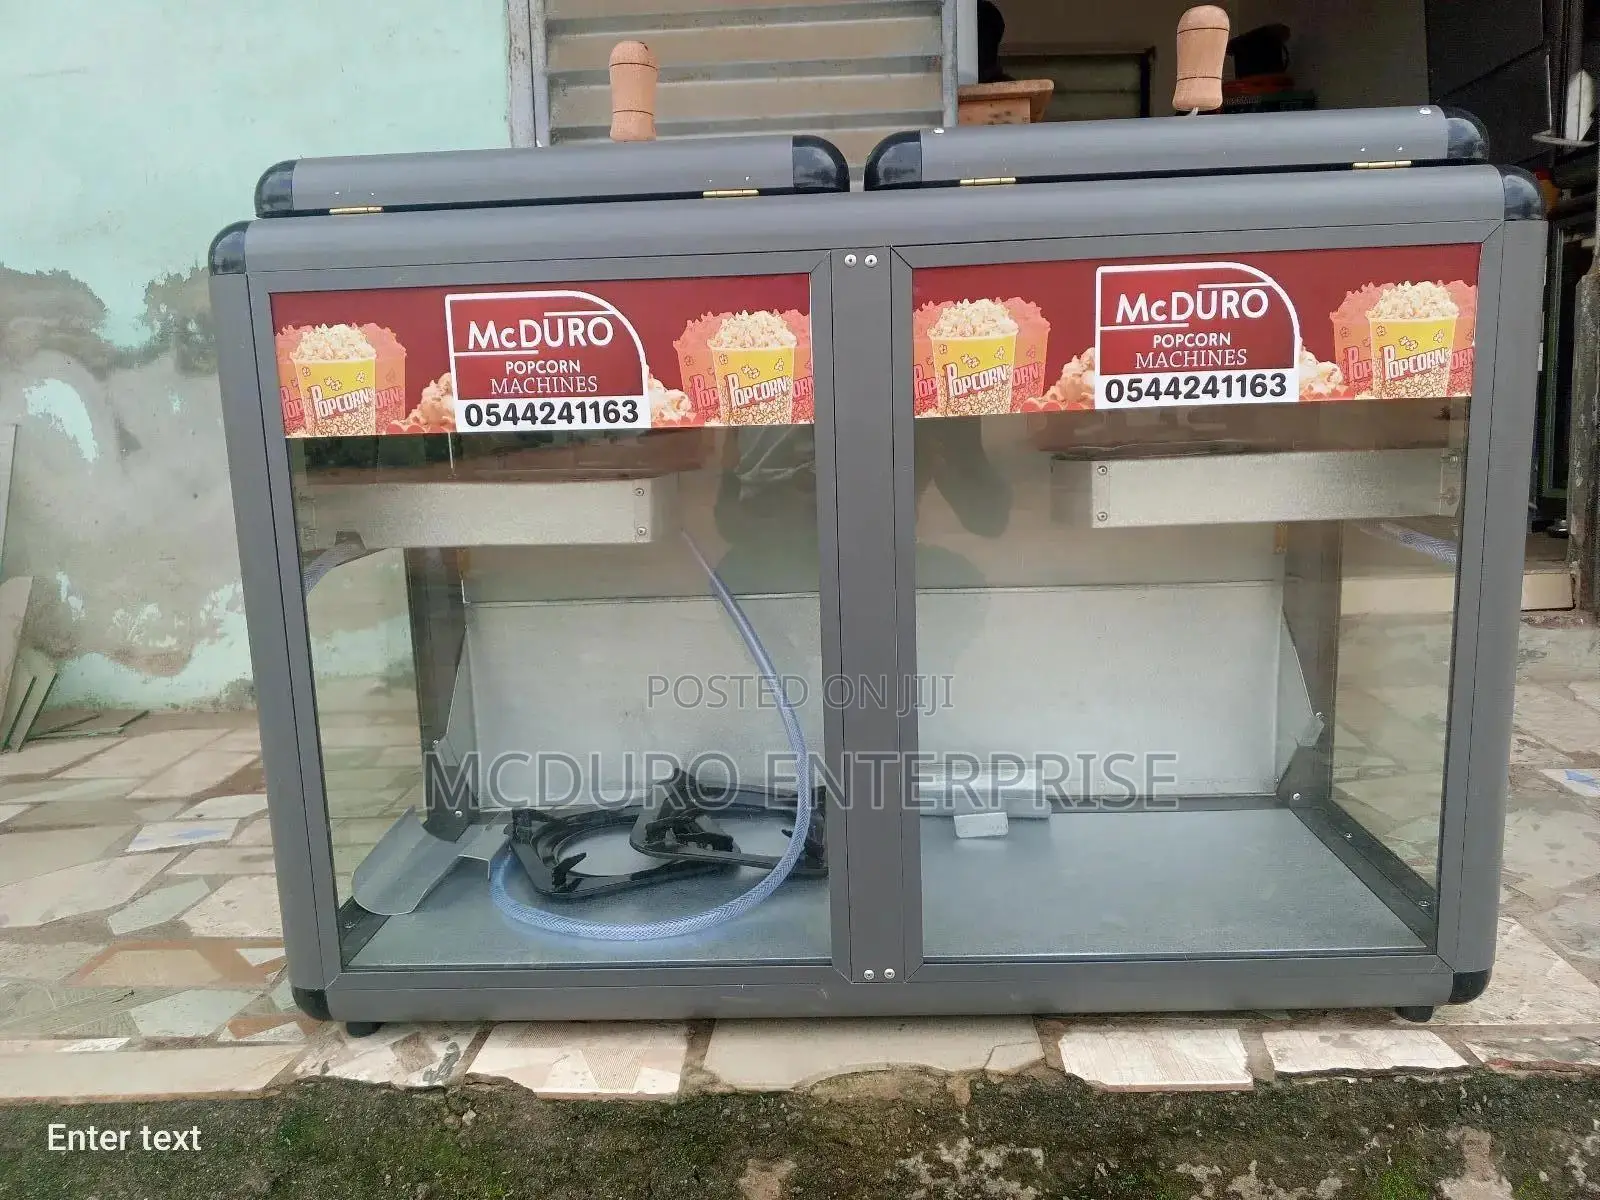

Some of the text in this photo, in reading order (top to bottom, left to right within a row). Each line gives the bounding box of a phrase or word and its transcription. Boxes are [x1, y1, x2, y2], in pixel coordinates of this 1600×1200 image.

[1115, 287, 1269, 324] McDURO
[467, 316, 614, 350] McDURO
[1153, 332, 1231, 349] POPCORN
[505, 359, 581, 375] POPCORN
[1135, 347, 1247, 370] MACHINES
[490, 375, 598, 395] MACHINES
[1105, 372, 1287, 404] 0544241163
[464, 399, 639, 428] 0544241163
